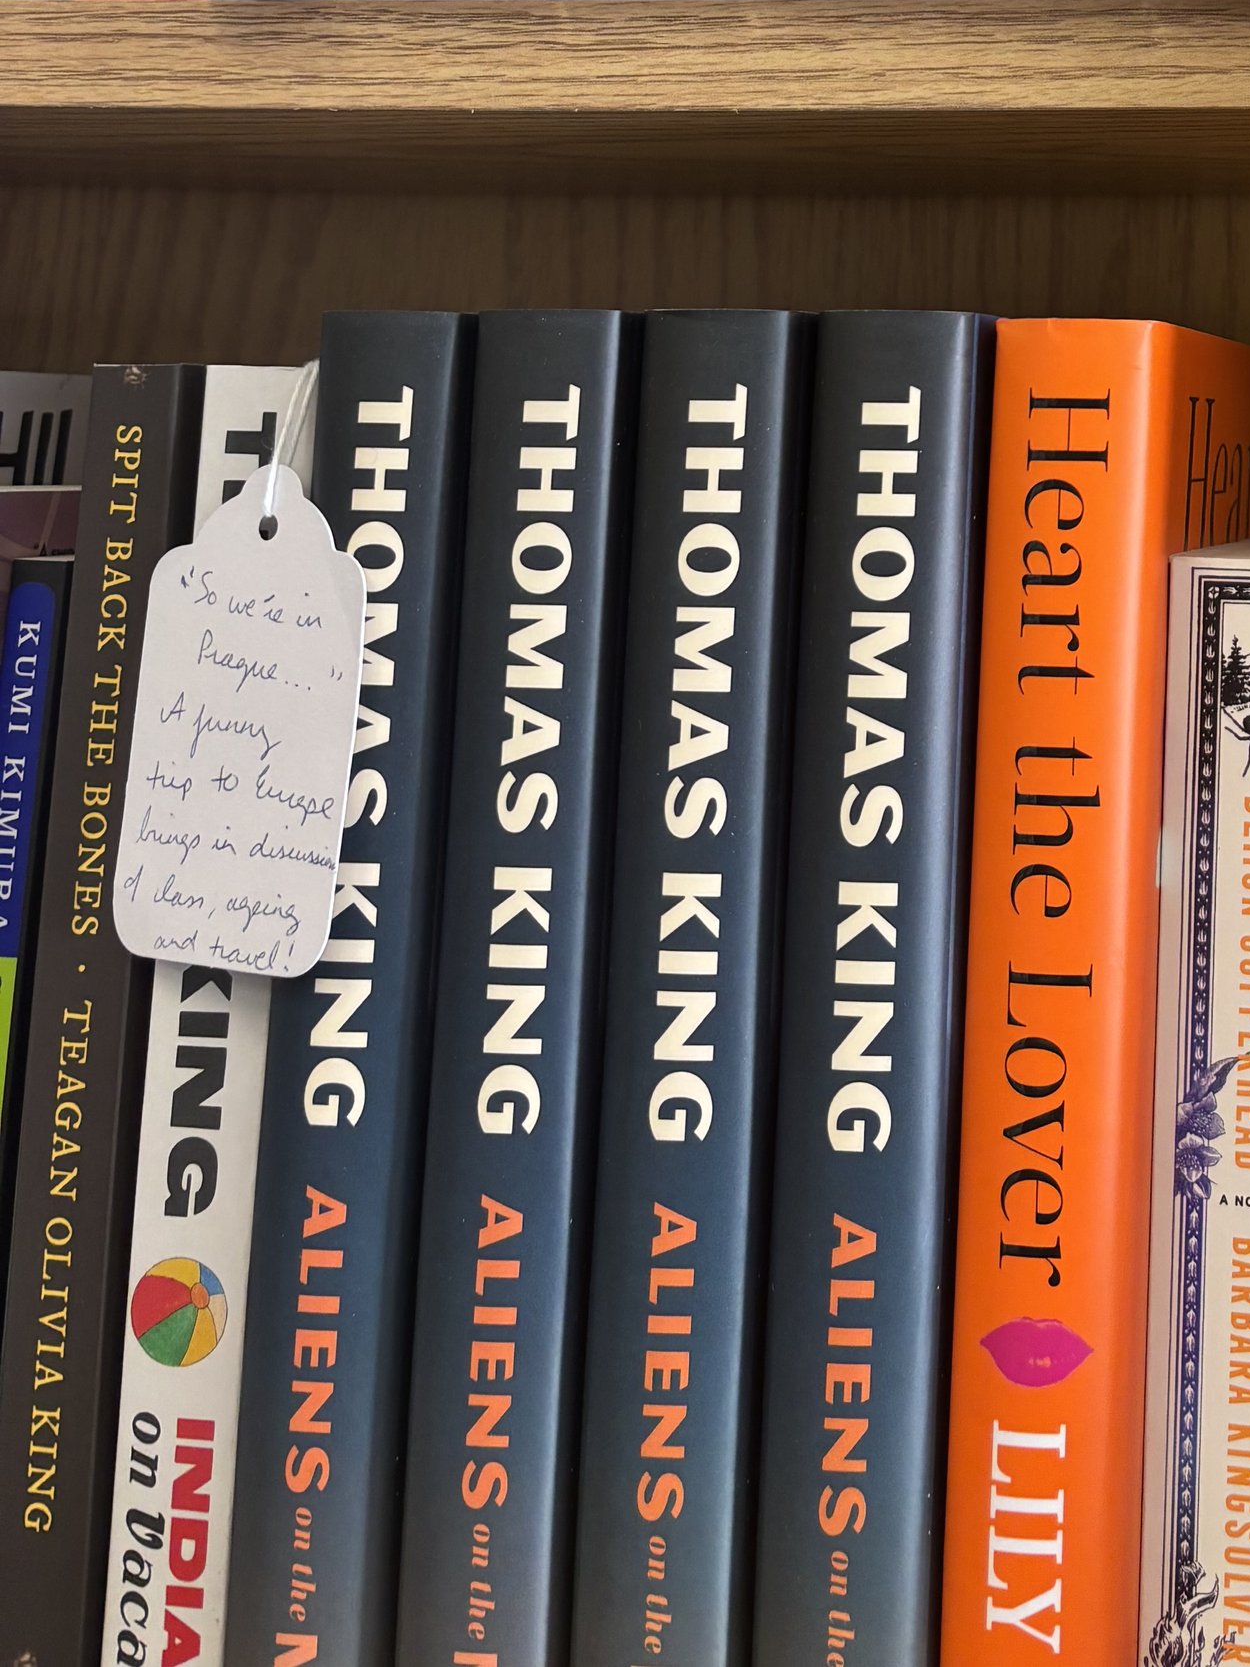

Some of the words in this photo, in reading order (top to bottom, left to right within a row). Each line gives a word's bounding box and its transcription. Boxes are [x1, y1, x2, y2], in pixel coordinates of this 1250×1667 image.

[110, 424, 143, 524] SPIT
[97, 535, 134, 650] BACK
[1016, 388, 1112, 696] Heart
[296, 592, 322, 629] in
[496, 384, 581, 834] THOMAS
[665, 383, 749, 839] THOMAS
[8, 620, 40, 735] KUMI
[161, 692, 185, 722] A
[137, 806, 200, 864] brings
[212, 826, 236, 855] in
[147, 762, 193, 800] trip
[212, 765, 238, 792] to
[72, 781, 112, 936] BONES
[124, 865, 143, 901] of
[154, 930, 198, 950] and
[49, 1001, 90, 1202] TEAGAN
[999, 960, 1094, 1287] Lover
[1219, 1194, 1229, 1205] A
[32, 1216, 74, 1391] OLIVIA
[285, 1184, 347, 1494] ALIENS
[461, 1194, 524, 1510] ALIENS
[636, 1201, 698, 1521] ALIENS
[24, 1406, 60, 1532] KING
[129, 1411, 161, 1488] on
[295, 1506, 313, 1551] on
[472, 1523, 490, 1568] on
[985, 1420, 1067, 1655] LILY
[290, 1563, 316, 1622] the
[467, 1580, 496, 1641] the
